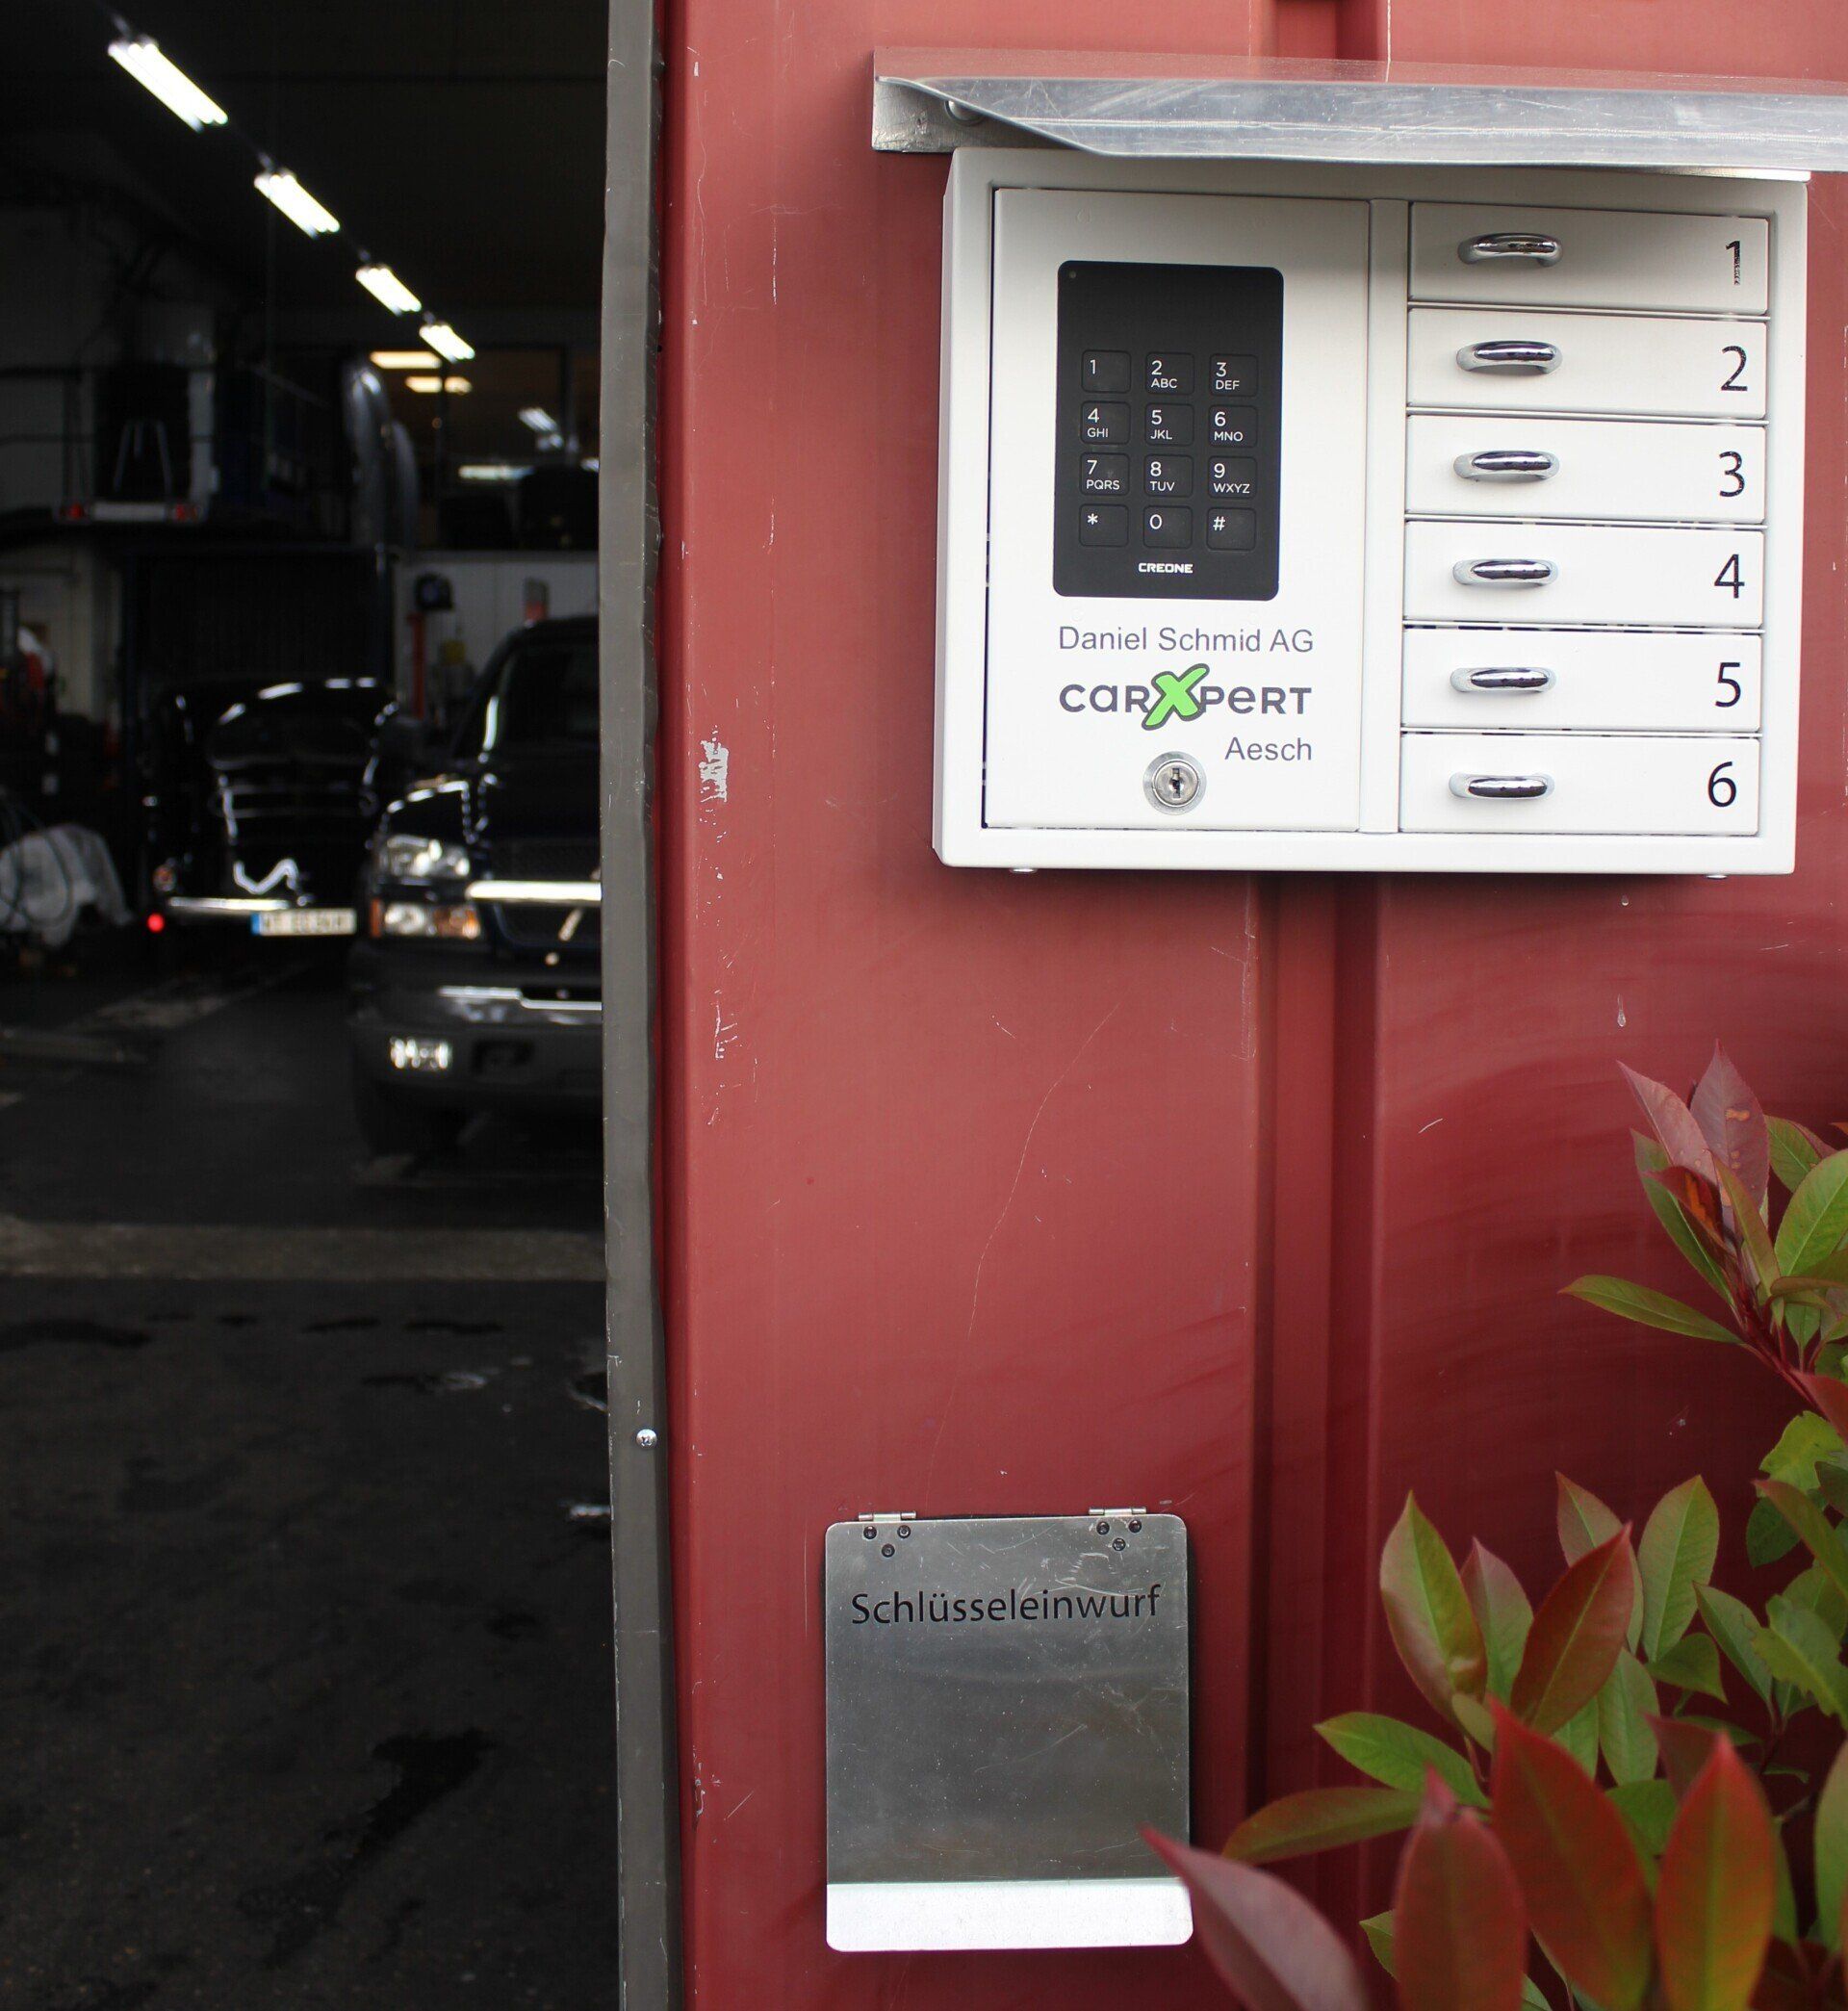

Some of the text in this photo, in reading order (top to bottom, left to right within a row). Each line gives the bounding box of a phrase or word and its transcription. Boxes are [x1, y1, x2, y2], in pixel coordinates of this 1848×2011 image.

[1725, 240, 1741, 286] 1
[1151, 359, 1163, 375] 2
[1216, 361, 1227, 377] 3
[1721, 346, 1748, 392] 2
[1150, 377, 1178, 389] ABC
[1215, 379, 1241, 391] DEF
[1087, 407, 1100, 424] 4
[1151, 409, 1163, 425] 5
[1214, 411, 1226, 427] 6
[1087, 426, 1109, 438] GHI
[1150, 428, 1173, 440] JKL
[1214, 430, 1244, 442] MNO
[1087, 459, 1098, 476] 7
[1149, 460, 1162, 477] 8
[1214, 462, 1226, 479] 9
[1719, 451, 1745, 498] 3
[1086, 478, 1120, 491] PQRS
[1149, 480, 1175, 492] TUV
[1213, 482, 1250, 494] WXYZ
[1138, 562, 1194, 574] CREONE
[1714, 554, 1745, 599] 4
[1059, 626, 1314, 653] Daniel Schmid AG
[1715, 661, 1741, 708] 5
[1224, 736, 1312, 761] Aesch
[1707, 761, 1737, 808] 6
[851, 1584, 1162, 1625] Schlüsseleinwurf
